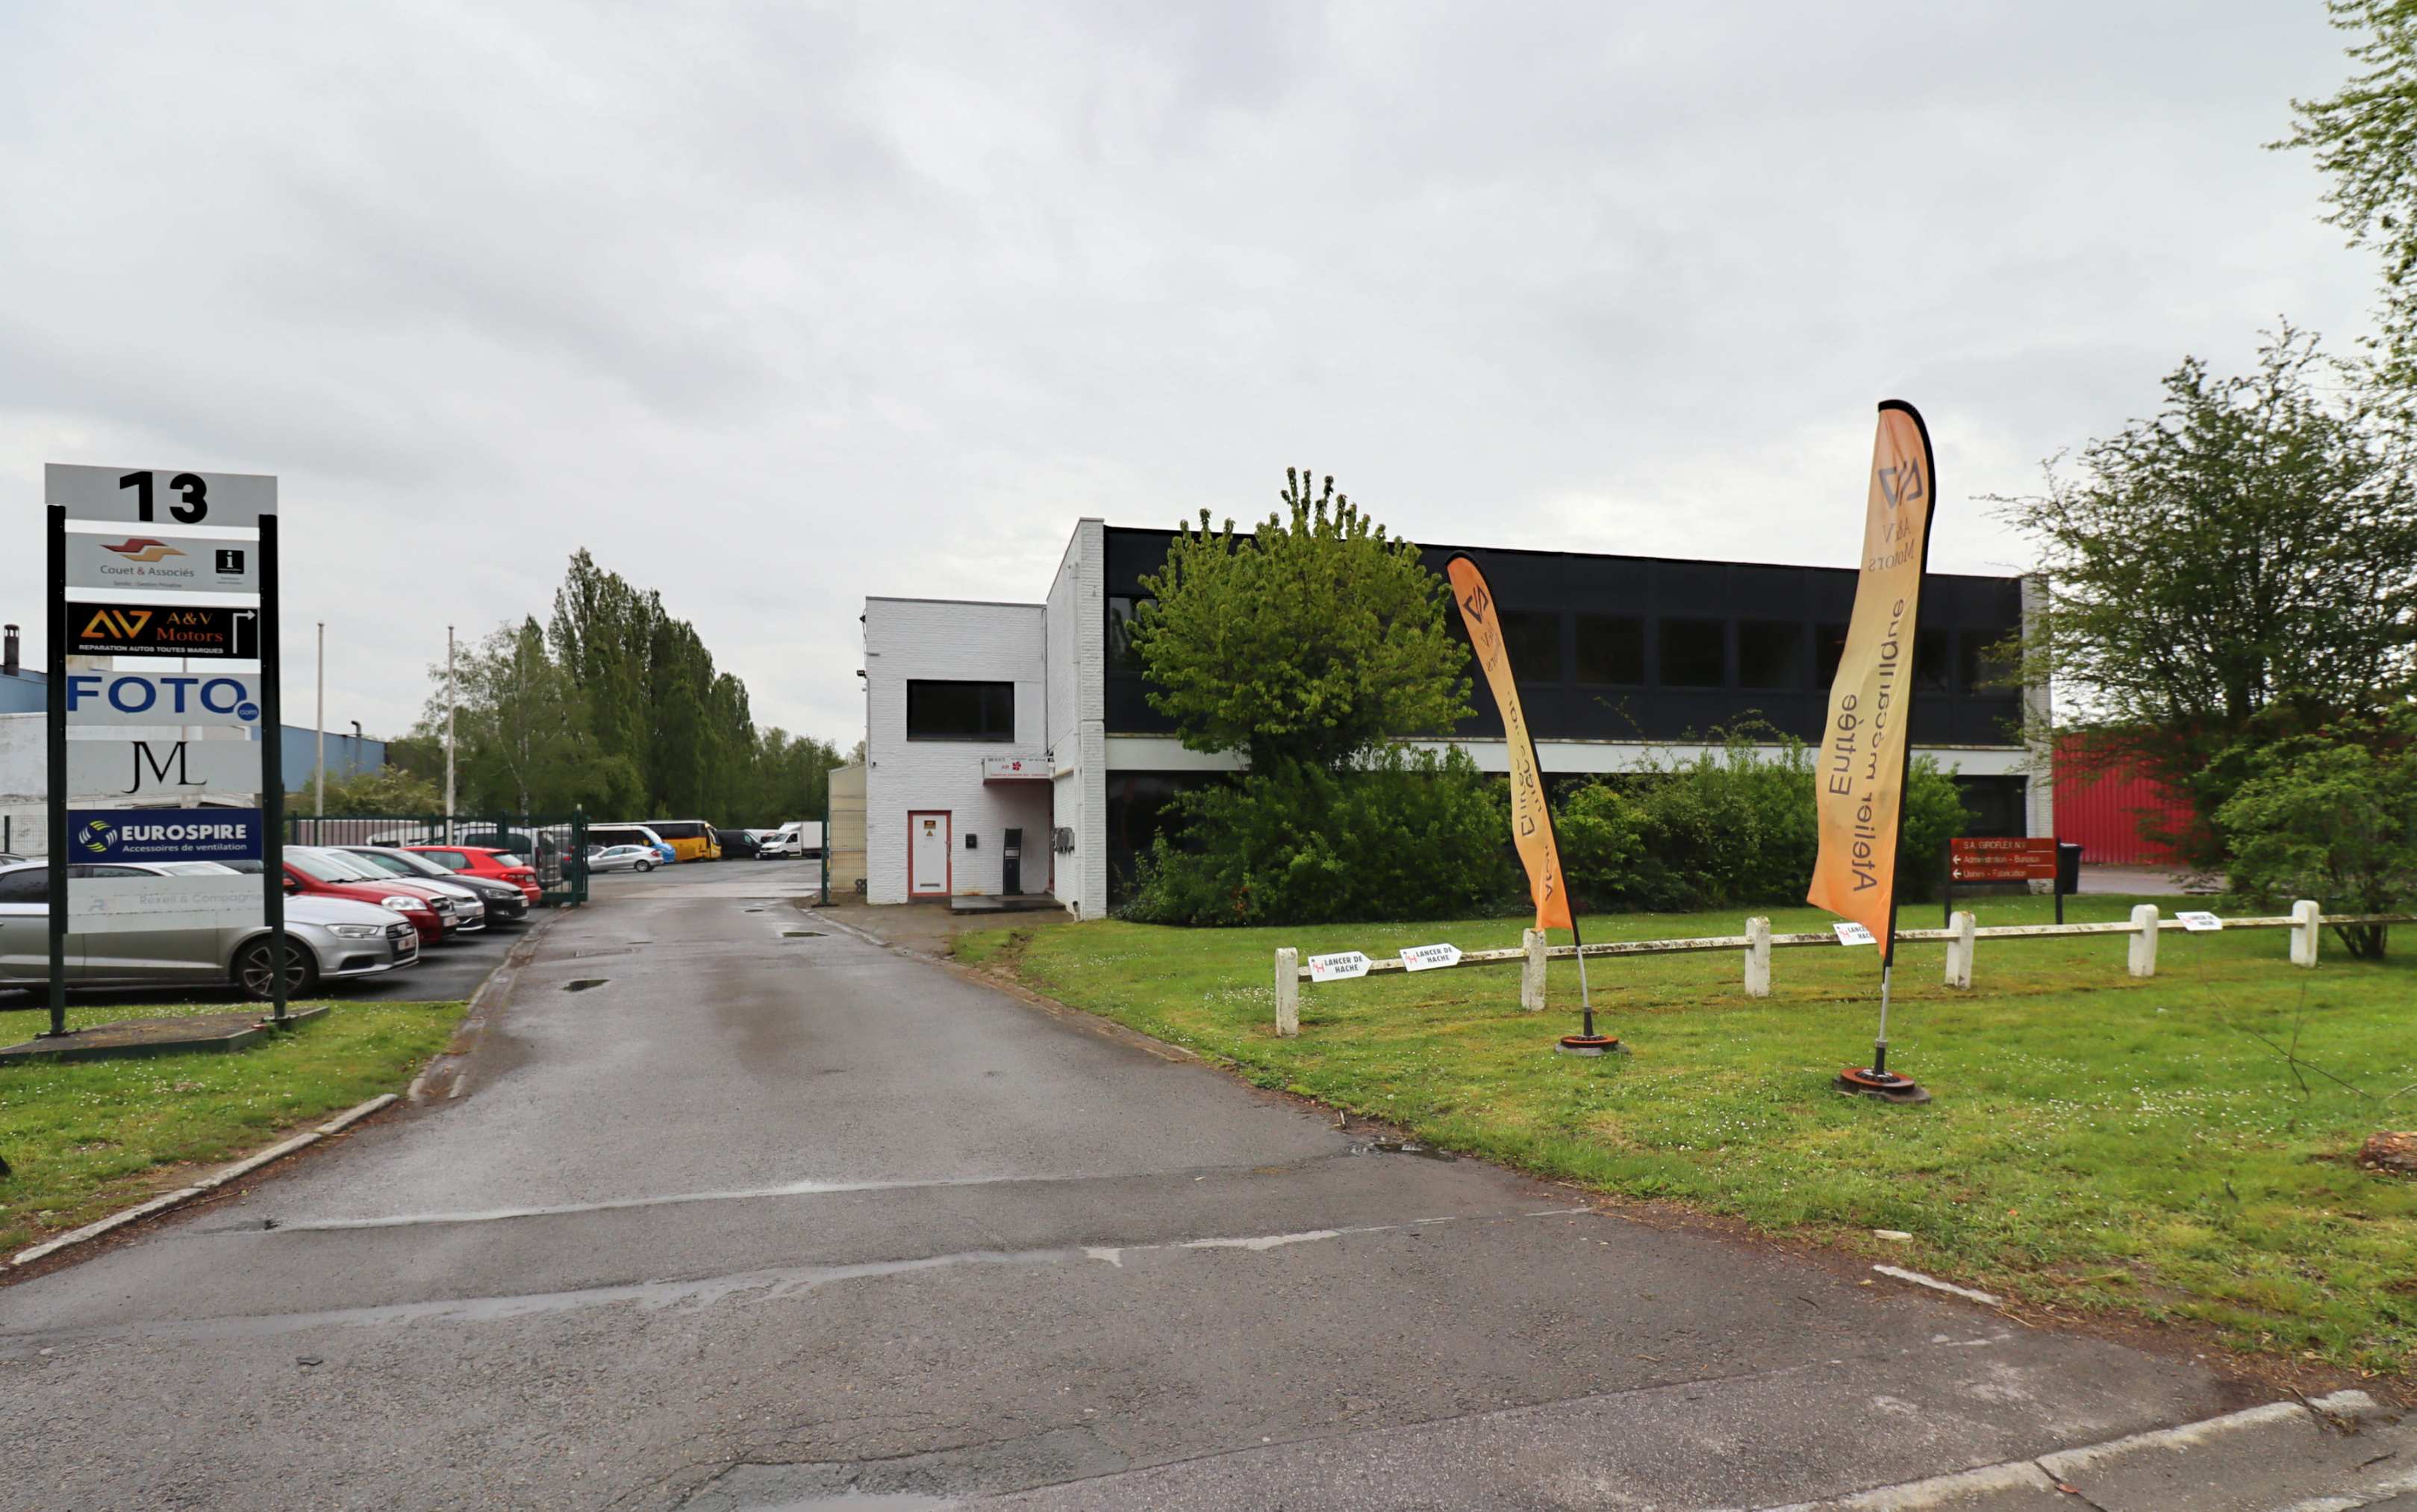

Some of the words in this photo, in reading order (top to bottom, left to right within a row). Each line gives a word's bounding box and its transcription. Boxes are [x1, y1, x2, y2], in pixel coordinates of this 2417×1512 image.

[119, 471, 208, 524] 13
[100, 565, 134, 575] Couet
[137, 566, 145, 575] &
[149, 566, 195, 578] Associés
[166, 611, 213, 625] A&V
[156, 627, 223, 642] Motors
[67, 675, 247, 713] FOTO
[119, 741, 208, 793] JML
[122, 824, 247, 841] EUROSPIRE
[1979, 841, 2013, 849] GIROFLEX
[1416, 948, 1442, 957] LANCER
[1427, 955, 1450, 963] HACHE
[1324, 957, 1351, 966] LANCER
[1335, 964, 1359, 973] HACHE
